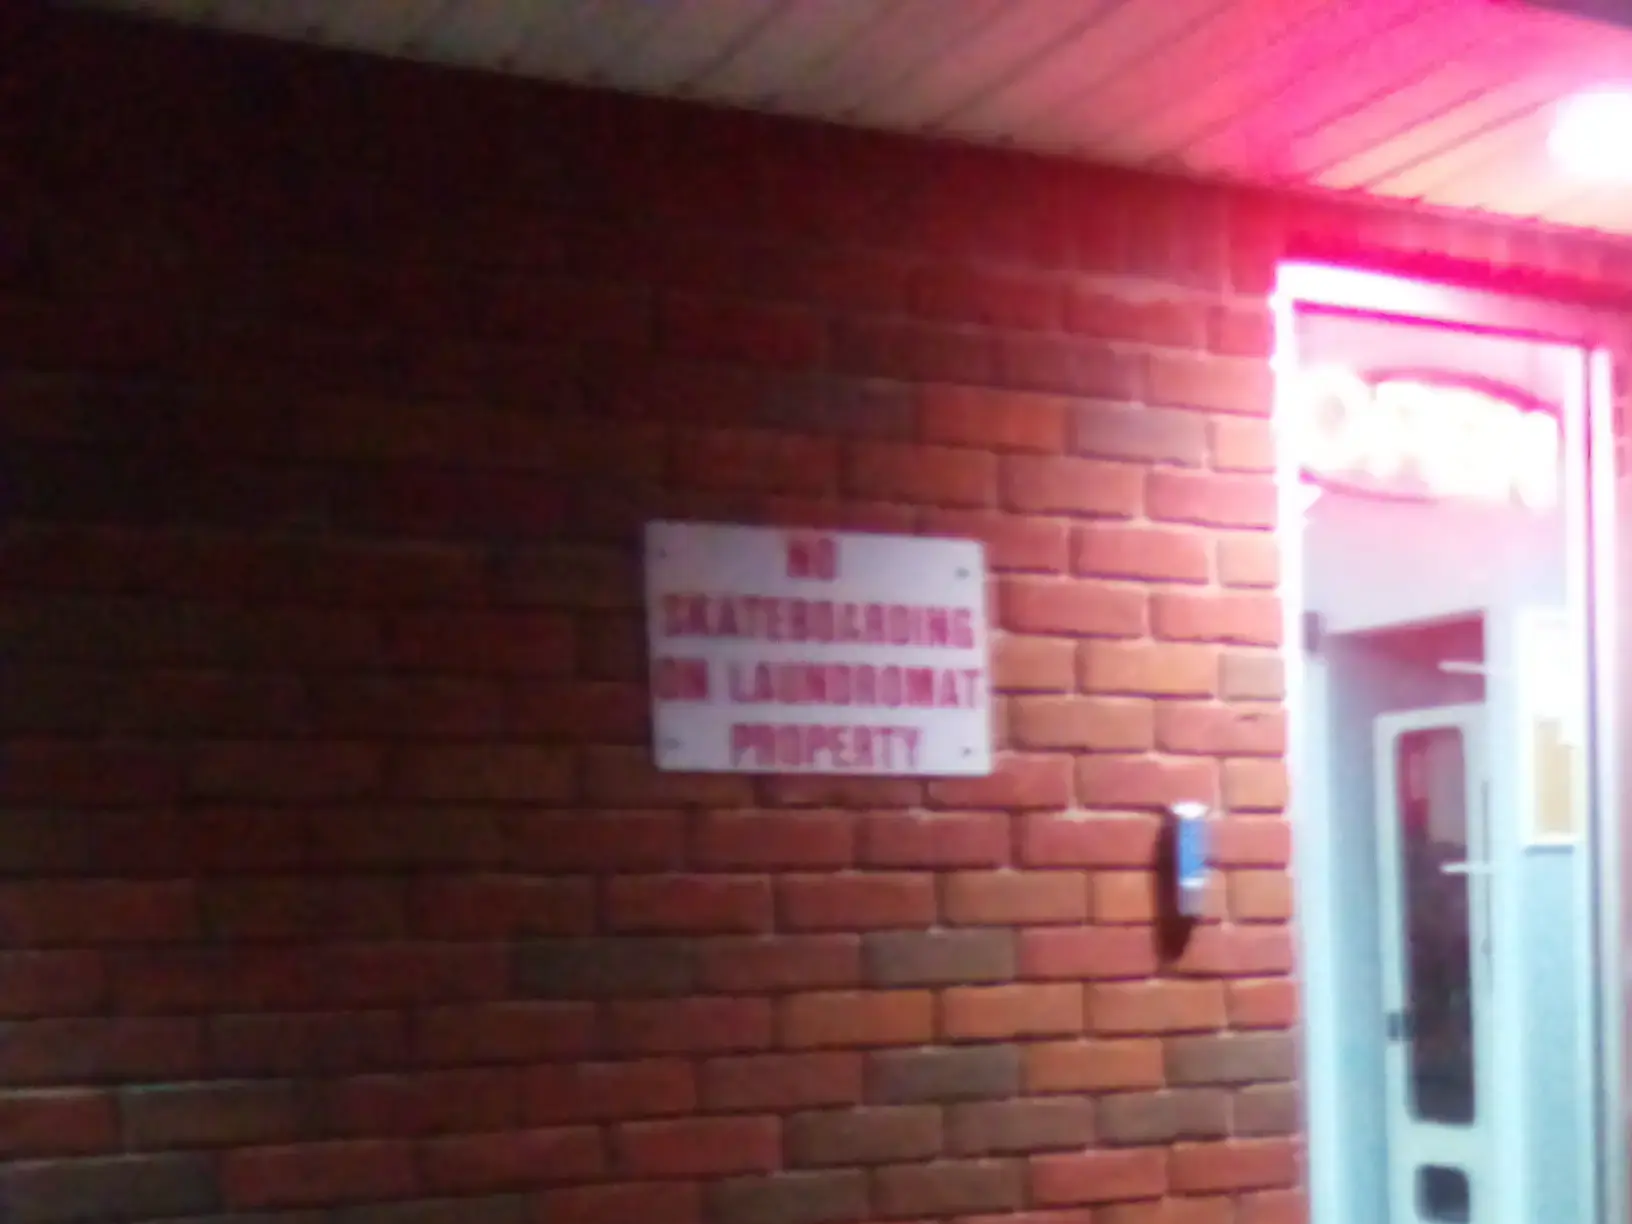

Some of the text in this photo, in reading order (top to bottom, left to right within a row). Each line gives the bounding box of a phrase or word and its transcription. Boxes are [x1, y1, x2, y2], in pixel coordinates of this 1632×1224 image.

[787, 537, 838, 581] NO
[663, 594, 975, 649] SKATEBOARDING
[728, 660, 984, 708] LAUNDROMAT
[731, 722, 924, 768] PROPERTY
